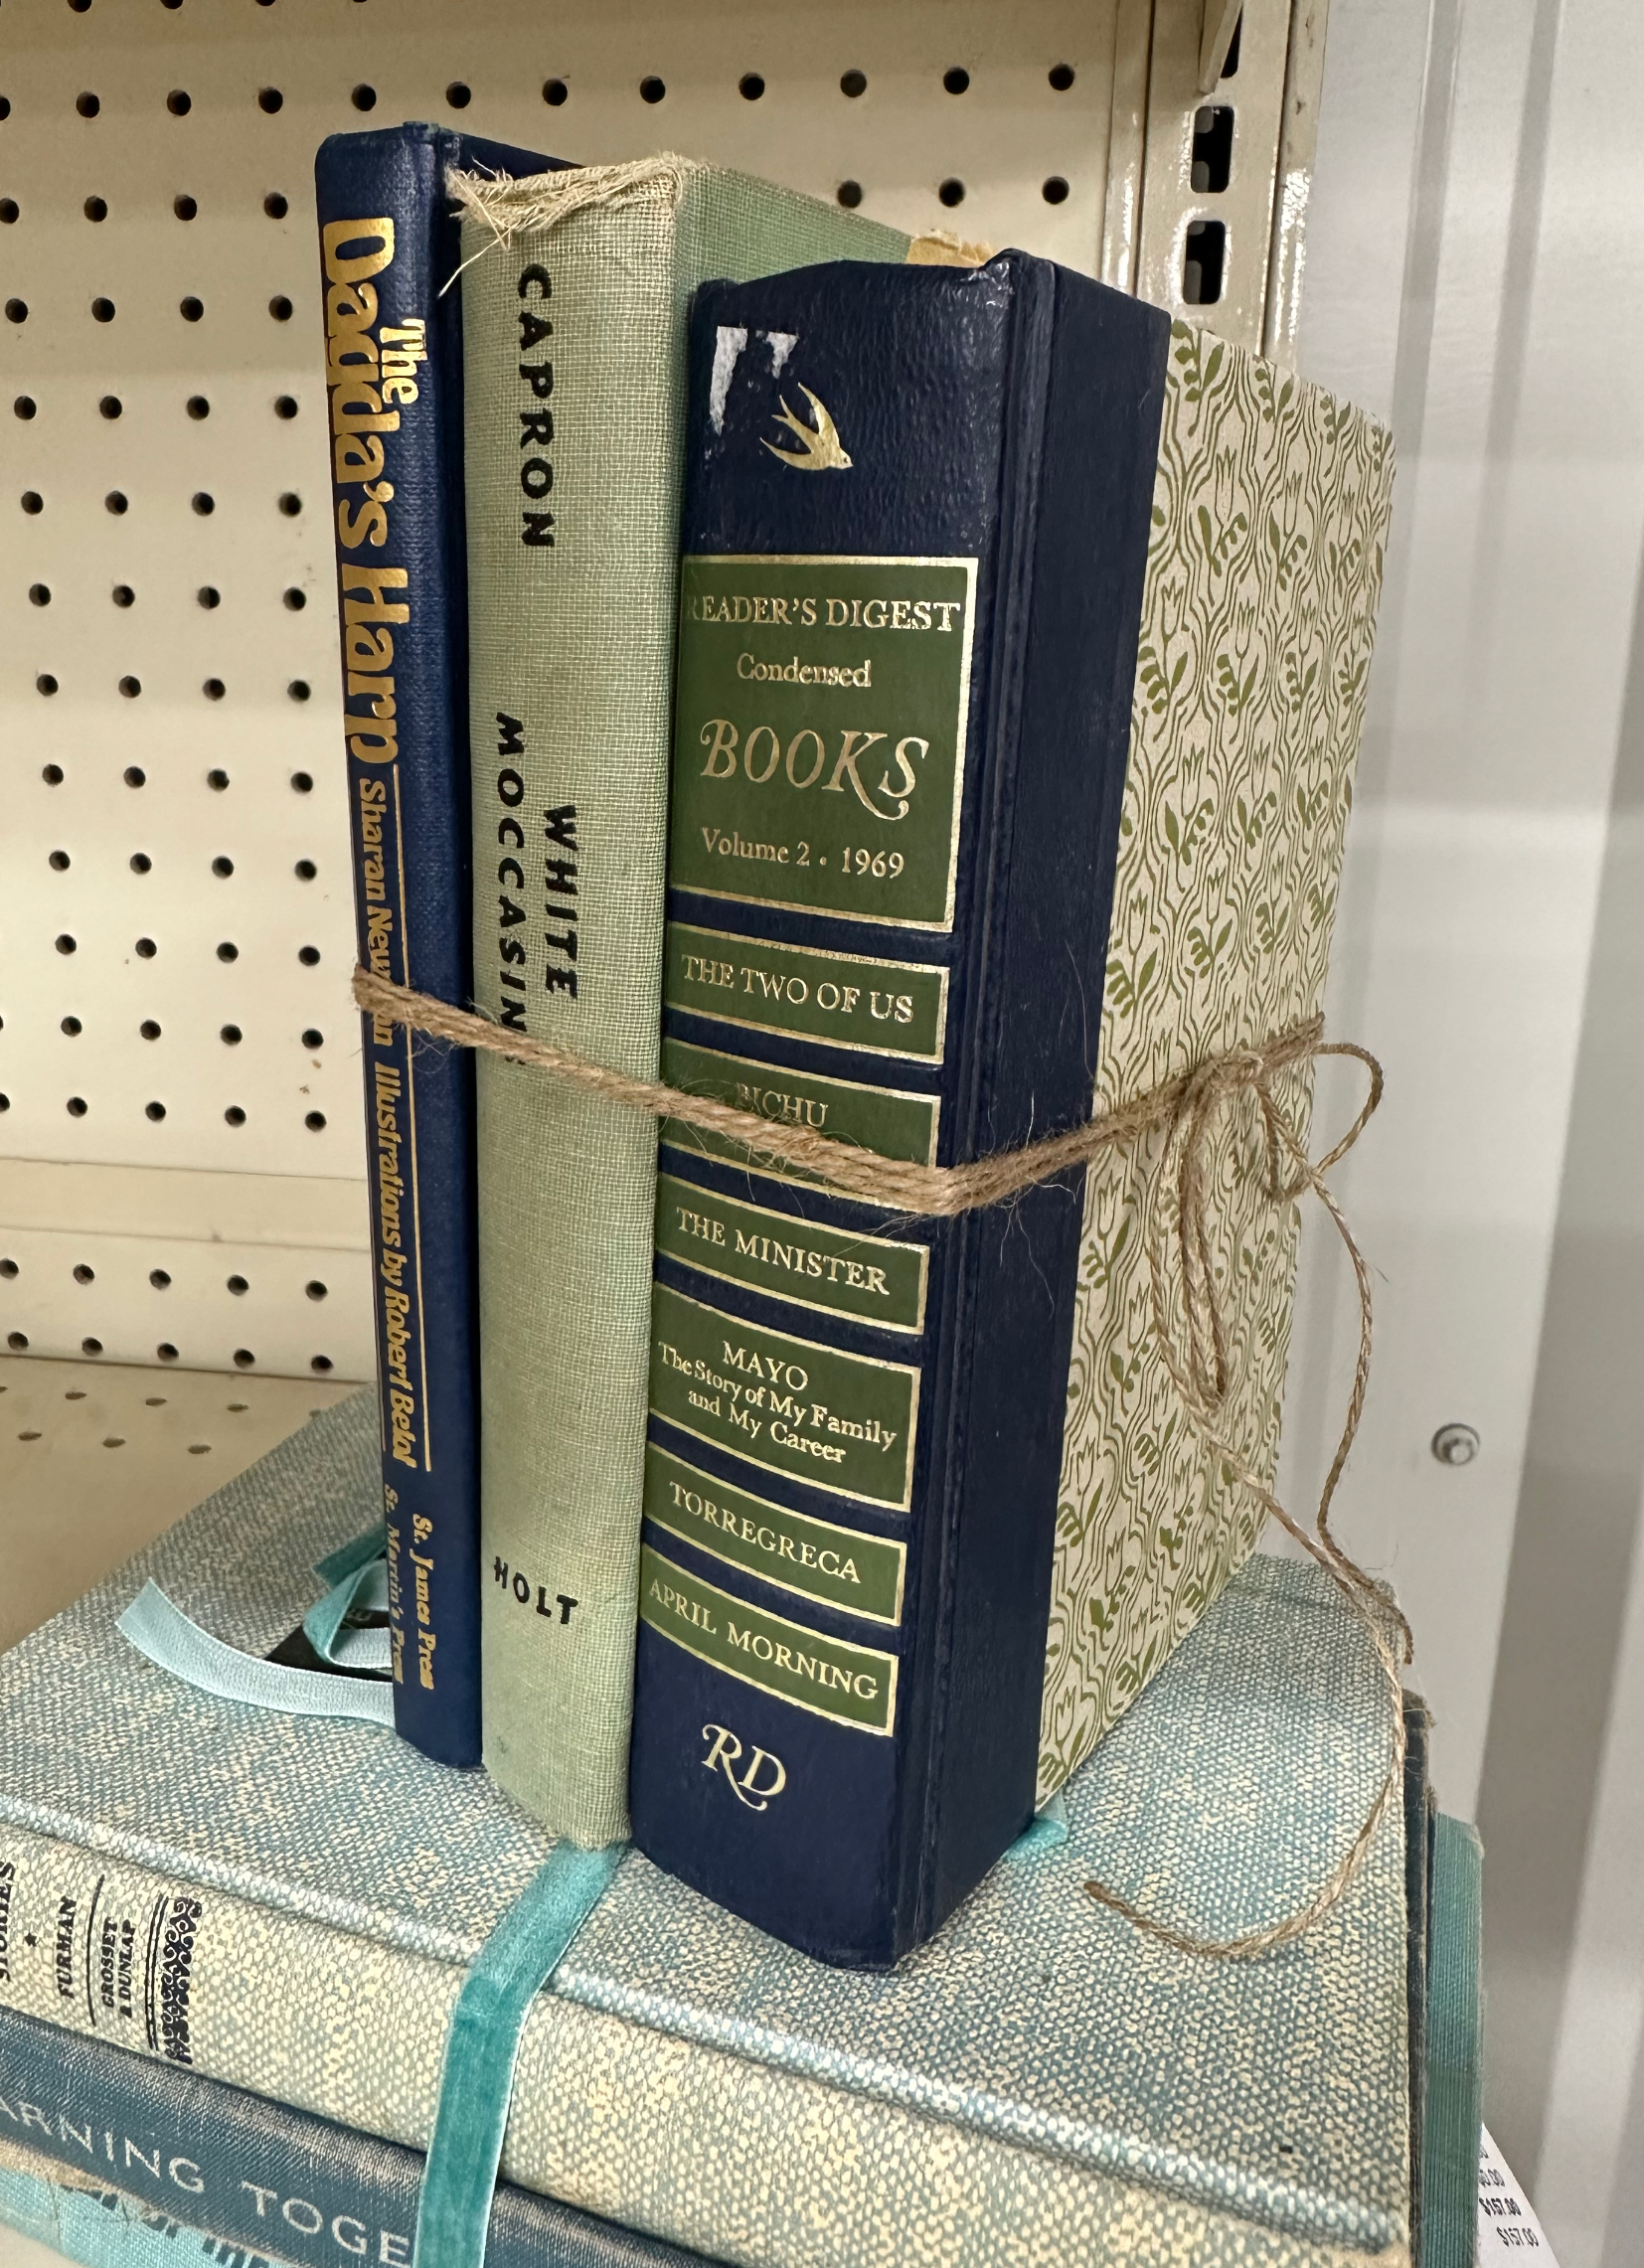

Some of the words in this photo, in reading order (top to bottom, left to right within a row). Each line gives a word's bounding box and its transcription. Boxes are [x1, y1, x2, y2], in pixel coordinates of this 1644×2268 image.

[322, 217, 401, 550] Dagda's
[379, 317, 427, 404] The
[516, 262, 555, 549] CAPRON
[825, 597, 961, 632] DIGEST
[341, 567, 410, 764] Harp
[736, 651, 873, 689] Condensed
[700, 718, 930, 822] BOOKS
[360, 777, 387, 901] Sharan
[701, 826, 790, 866] Volume
[795, 840, 811, 868] 2
[841, 846, 905, 880] 1969
[544, 804, 578, 1000] WHITE
[368, 905, 395, 1047] Newan
[681, 953, 736, 990] THE
[740, 966, 810, 1006] TWO
[816, 982, 861, 1014] OF
[869, 990, 914, 1024] US
[374, 1061, 405, 1248] Illustrations
[381, 1251, 408, 1288] by
[676, 1206, 727, 1247] THE
[734, 1228, 891, 1296] MINISTER
[386, 1288, 415, 1392] Robert
[722, 1340, 810, 1392] MAYO
[657, 1340, 694, 1377] The
[694, 1359, 743, 1402] Story
[745, 1385, 767, 1408] of
[768, 1389, 808, 1427] My
[810, 1402, 899, 1453] Family
[688, 1388, 723, 1417] and
[728, 1401, 763, 1439] My
[769, 1420, 848, 1465] Career
[668, 1480, 863, 1584] TORREGRECA
[409, 1547, 434, 1627] James
[493, 1555, 578, 1625] HOLT
[648, 1578, 718, 1635] APRIL
[727, 1620, 880, 1701] MORNING
[700, 1722, 787, 1812] RD
[57, 1894, 78, 2000] FURMAN
[118, 1918, 136, 2003] DUNLAP
